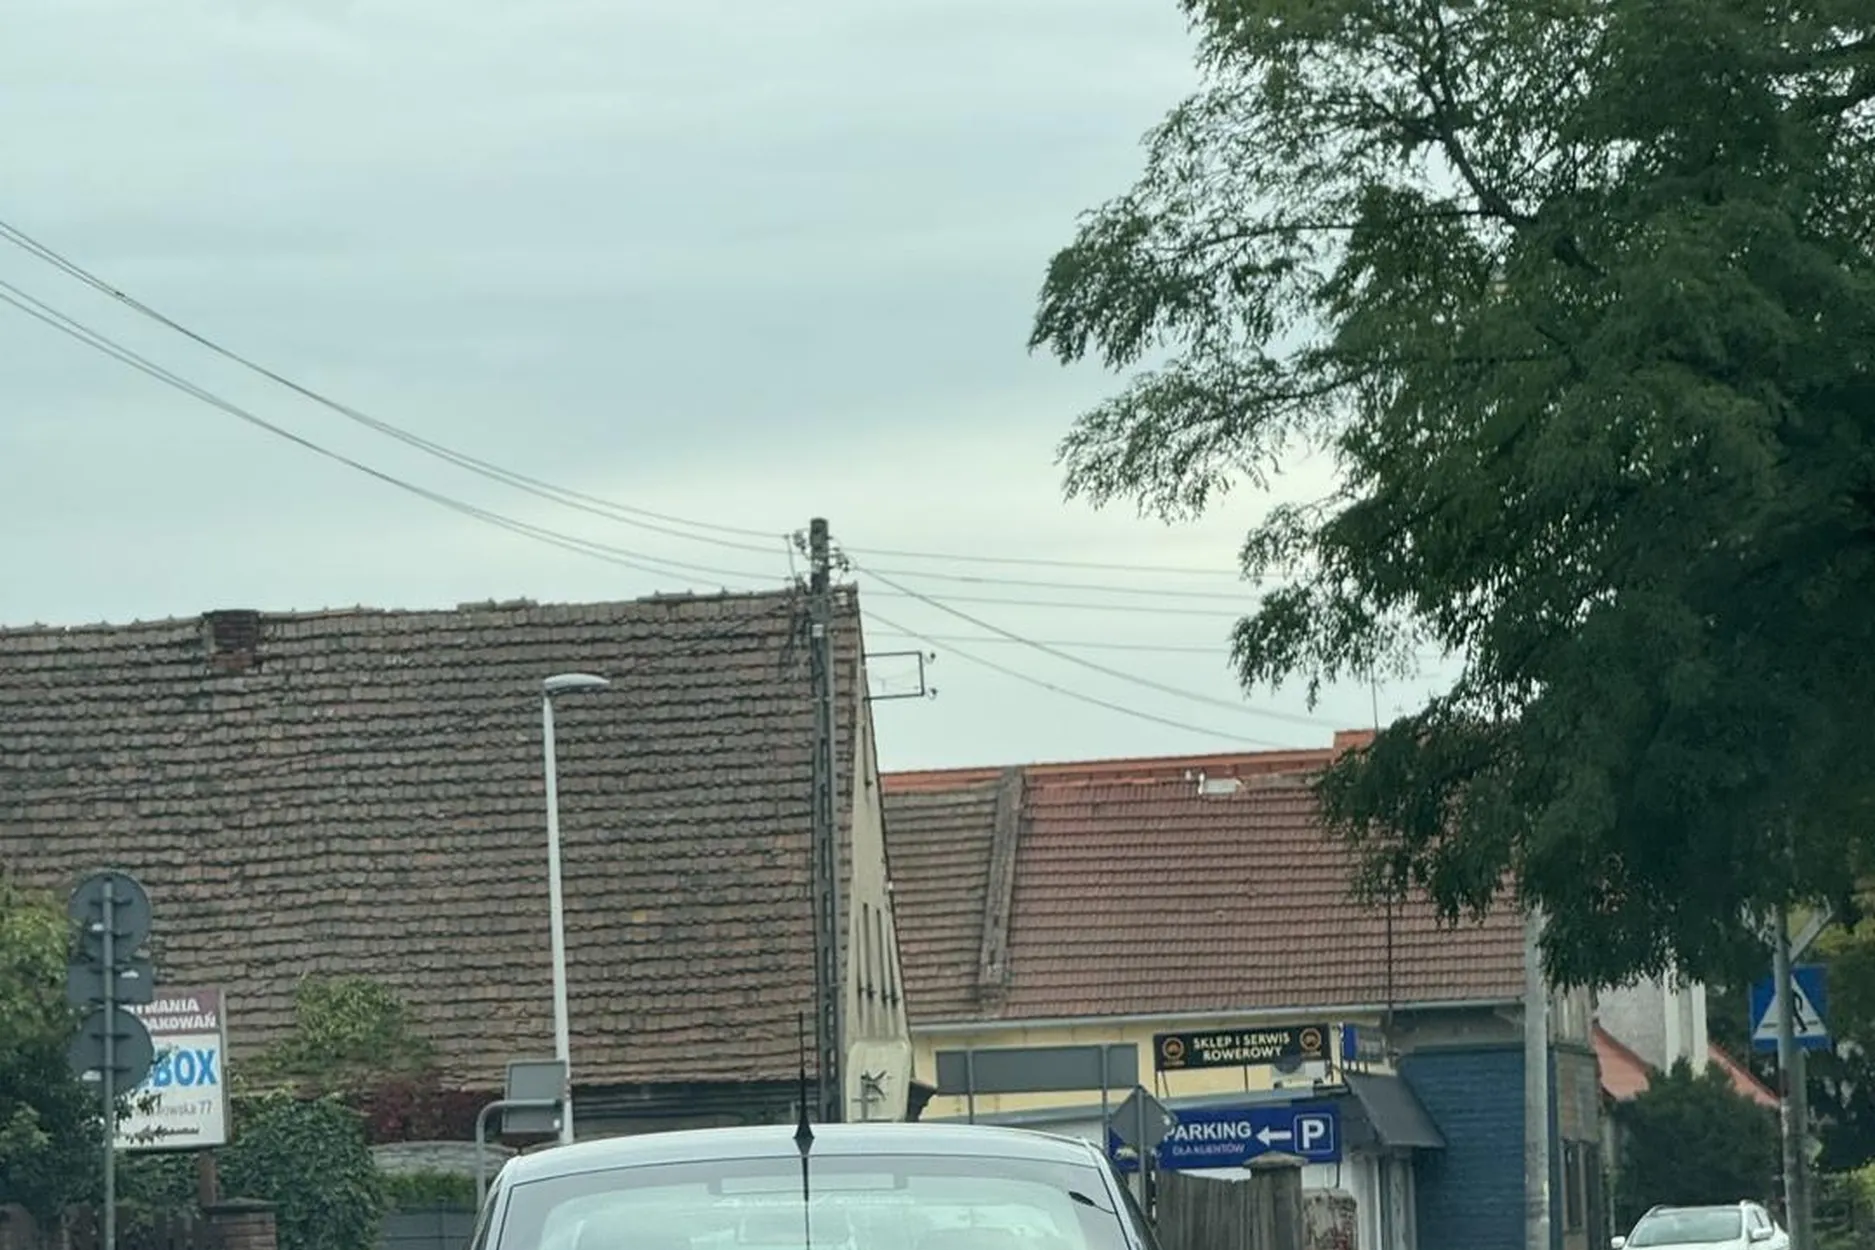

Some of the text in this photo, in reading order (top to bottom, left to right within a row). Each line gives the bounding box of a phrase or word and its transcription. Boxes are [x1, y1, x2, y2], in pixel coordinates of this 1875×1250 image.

[1193, 1035, 1232, 1050] SKLEP
[1243, 1032, 1291, 1046] SERWIS
[1203, 1046, 1282, 1061] ROWEROWY
[1302, 1119, 1325, 1149] P
